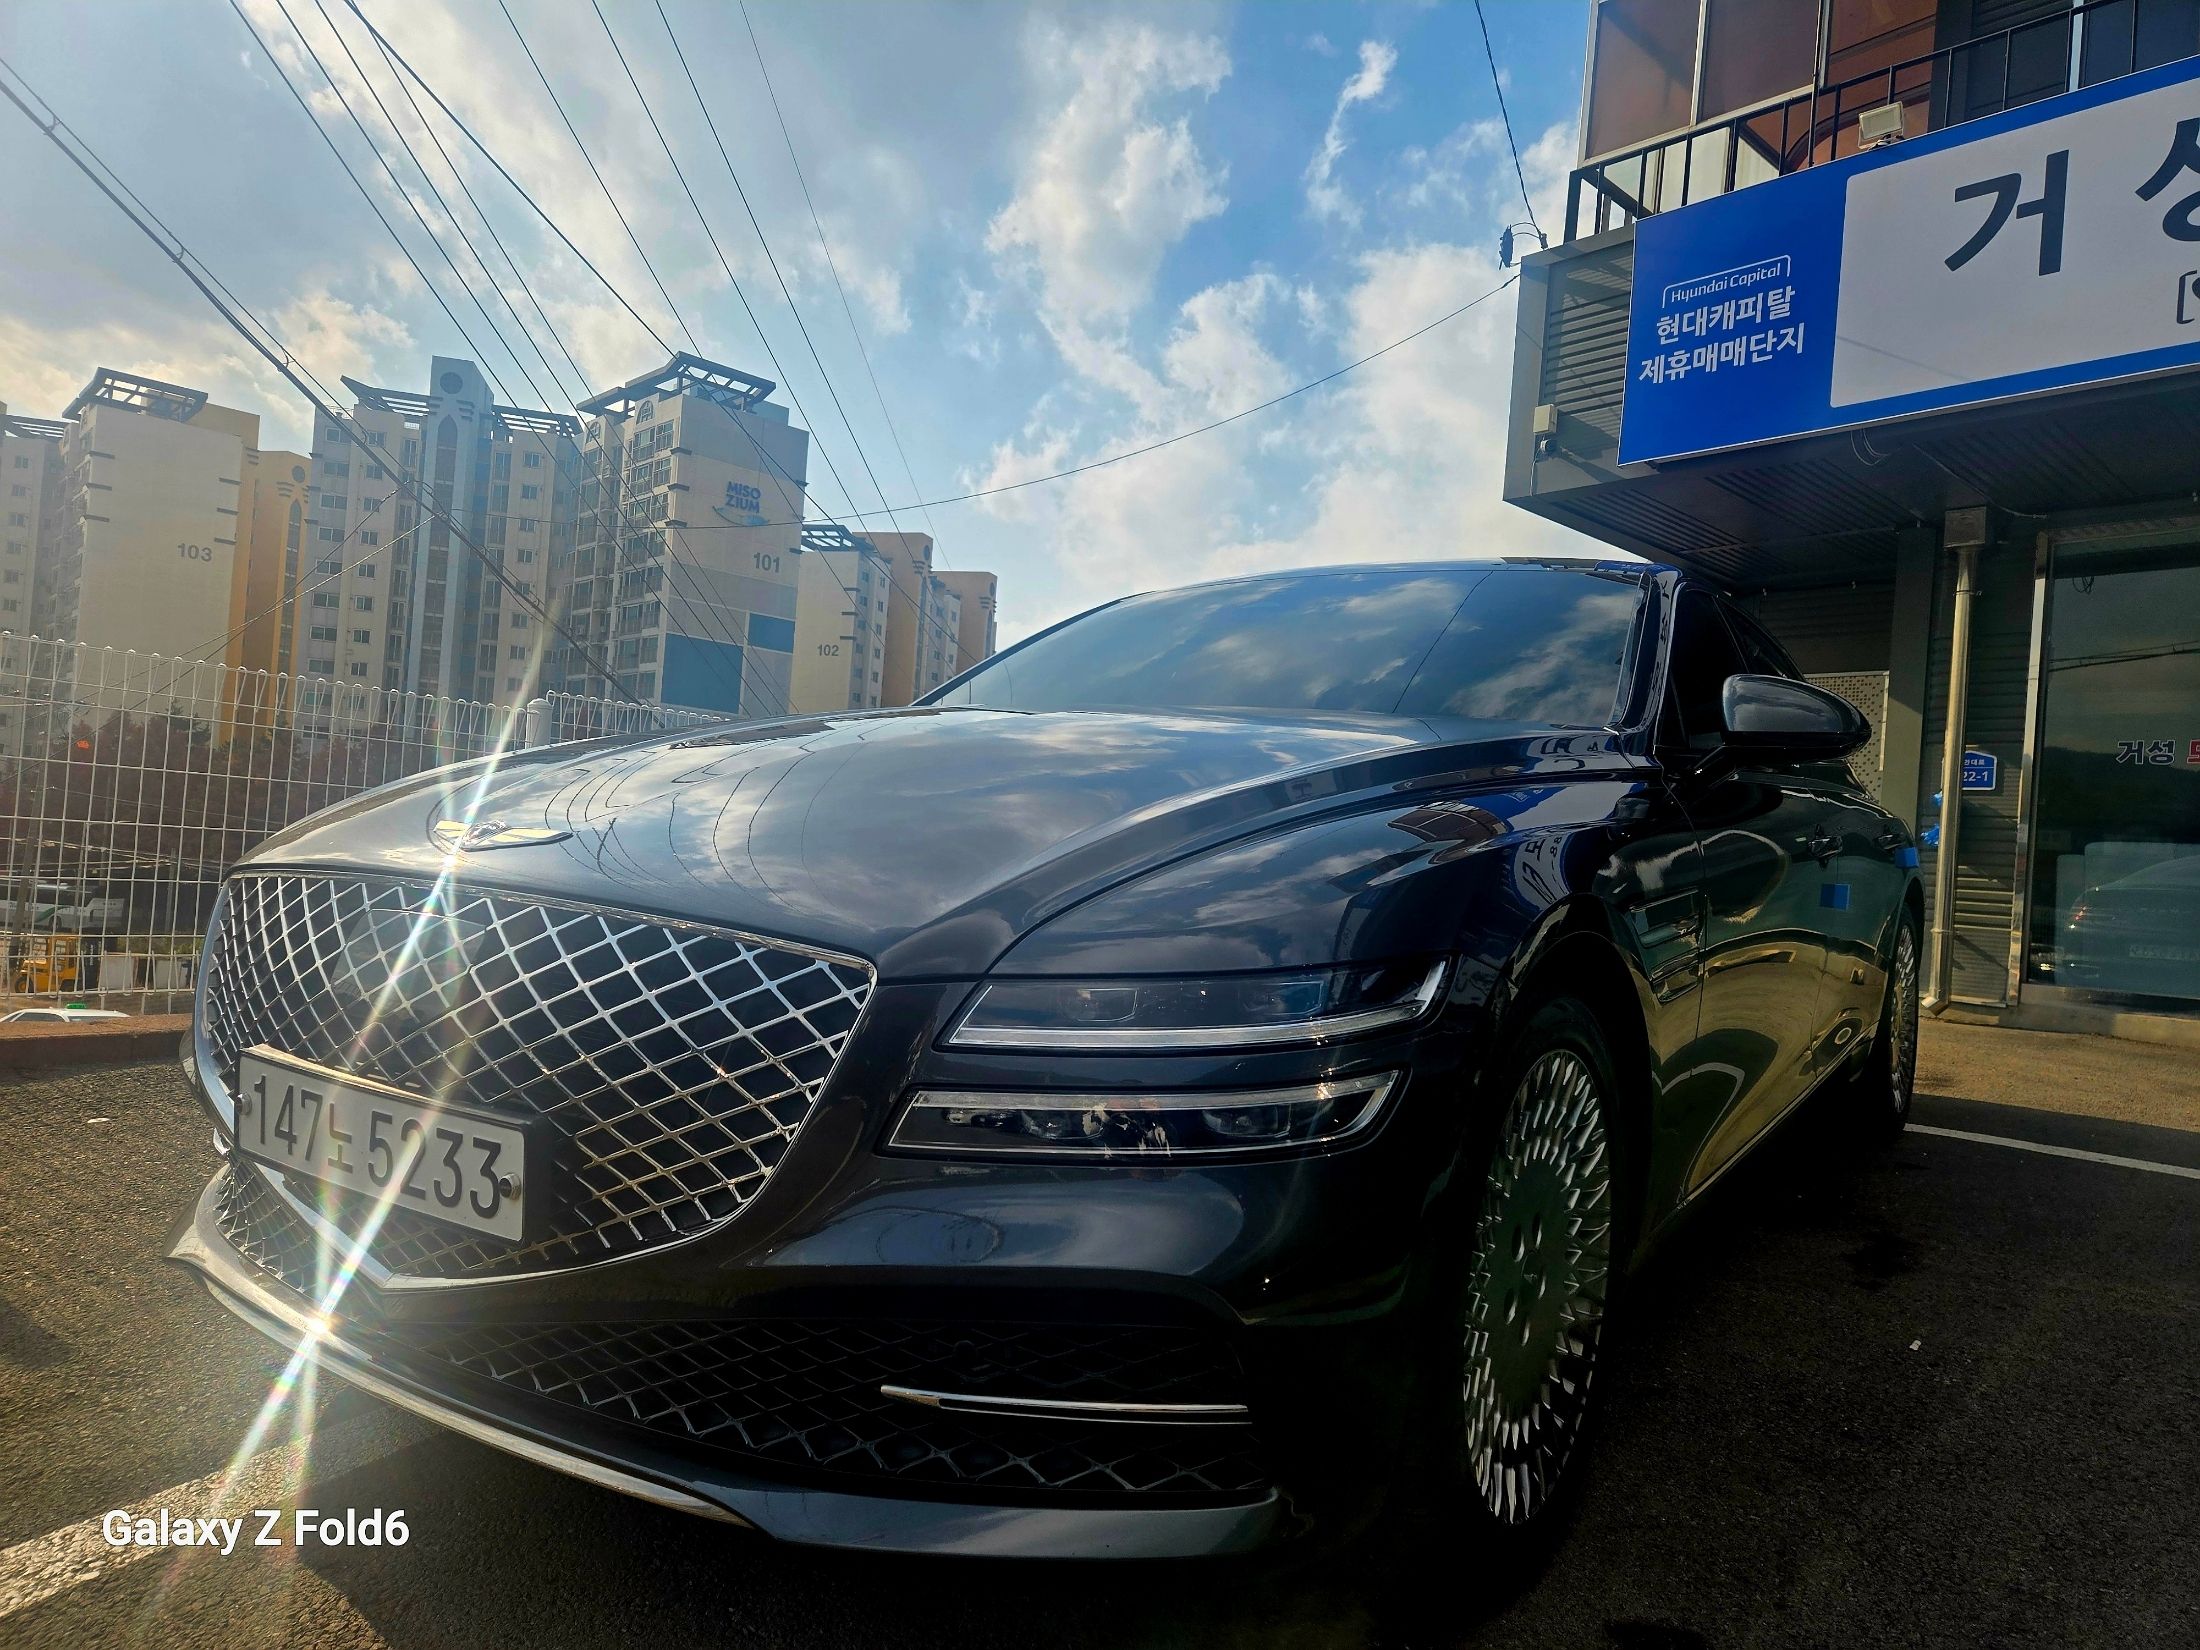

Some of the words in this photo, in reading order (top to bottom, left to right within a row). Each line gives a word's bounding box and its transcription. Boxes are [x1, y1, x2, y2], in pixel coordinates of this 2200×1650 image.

[1671, 277, 1728, 302] Hyundai
[1729, 263, 1781, 287] Capital
[1656, 285, 1796, 345] 현대캐피탈
[1638, 322, 1805, 384] 제휴매매단지
[726, 481, 761, 500] MISO
[725, 494, 760, 513] ZIUM
[177, 543, 212, 562] 103
[753, 552, 781, 573] 101
[816, 644, 839, 657] 102
[2115, 739, 2176, 766] 거성
[253, 1074, 353, 1174] 147노
[368, 1110, 502, 1219] 5233
